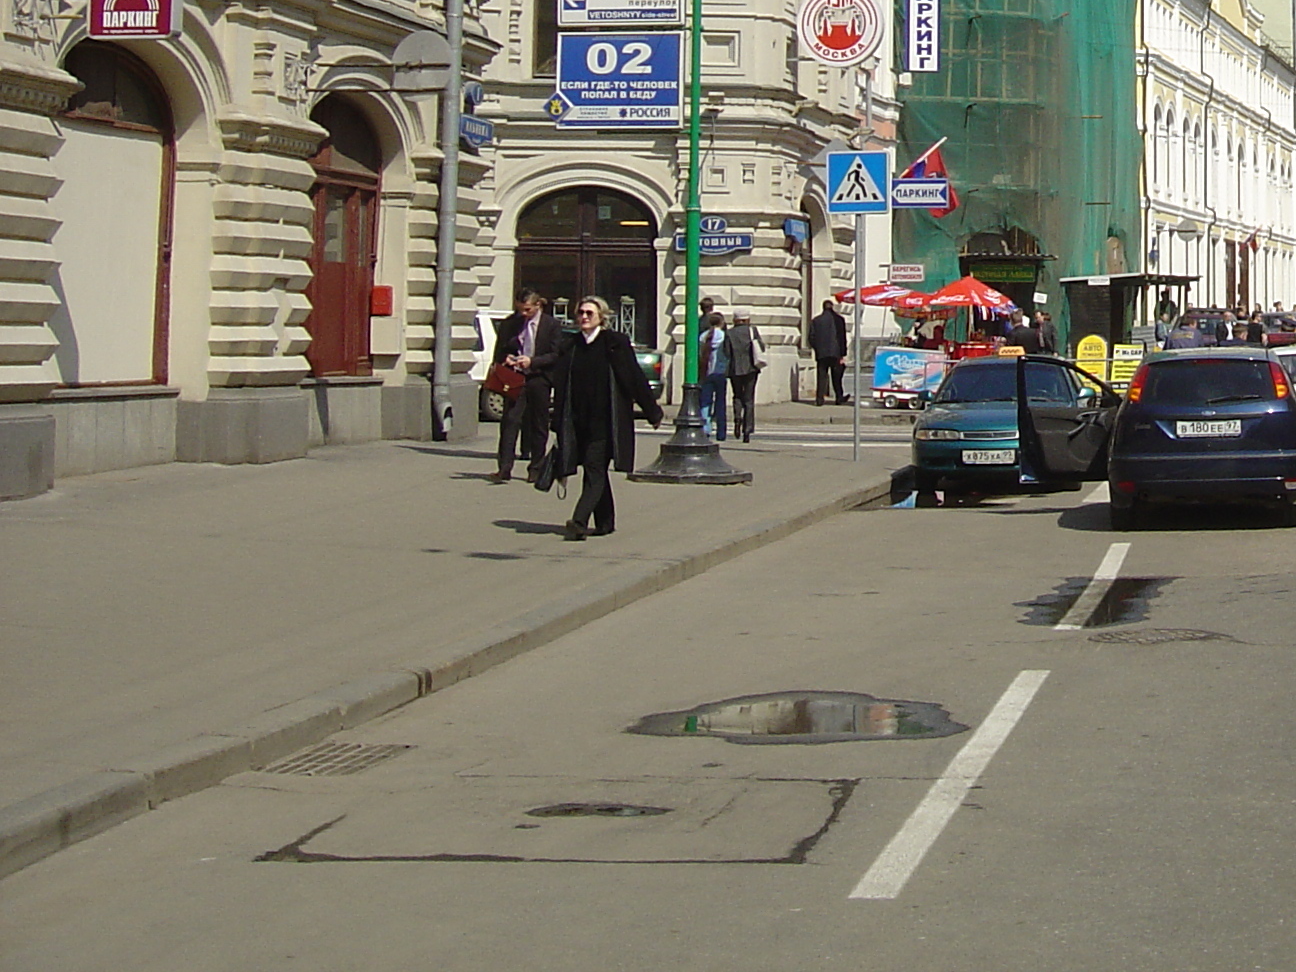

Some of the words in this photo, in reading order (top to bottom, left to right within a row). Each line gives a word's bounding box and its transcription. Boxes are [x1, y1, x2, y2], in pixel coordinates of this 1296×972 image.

[628, 0, 676, 7] переулок
[103, 11, 159, 27] ПАРКИНГ
[589, 11, 641, 19] VETOSHNYY
[813, 42, 866, 59] МОСКВА
[586, 42, 652, 75] 02
[561, 81, 588, 89] ЕСЛИ
[591, 81, 627, 90] ГДЕ-ТО
[630, 81, 678, 89] ЧЕЛОВЕК
[581, 91, 617, 99] ПОПАЛ
[620, 91, 627, 99] В
[629, 91, 657, 100] БЕДУ
[629, 108, 671, 118] РОССИЯ
[895, 188, 940, 199] ПАРКИНГ
[707, 219, 721, 230] 17
